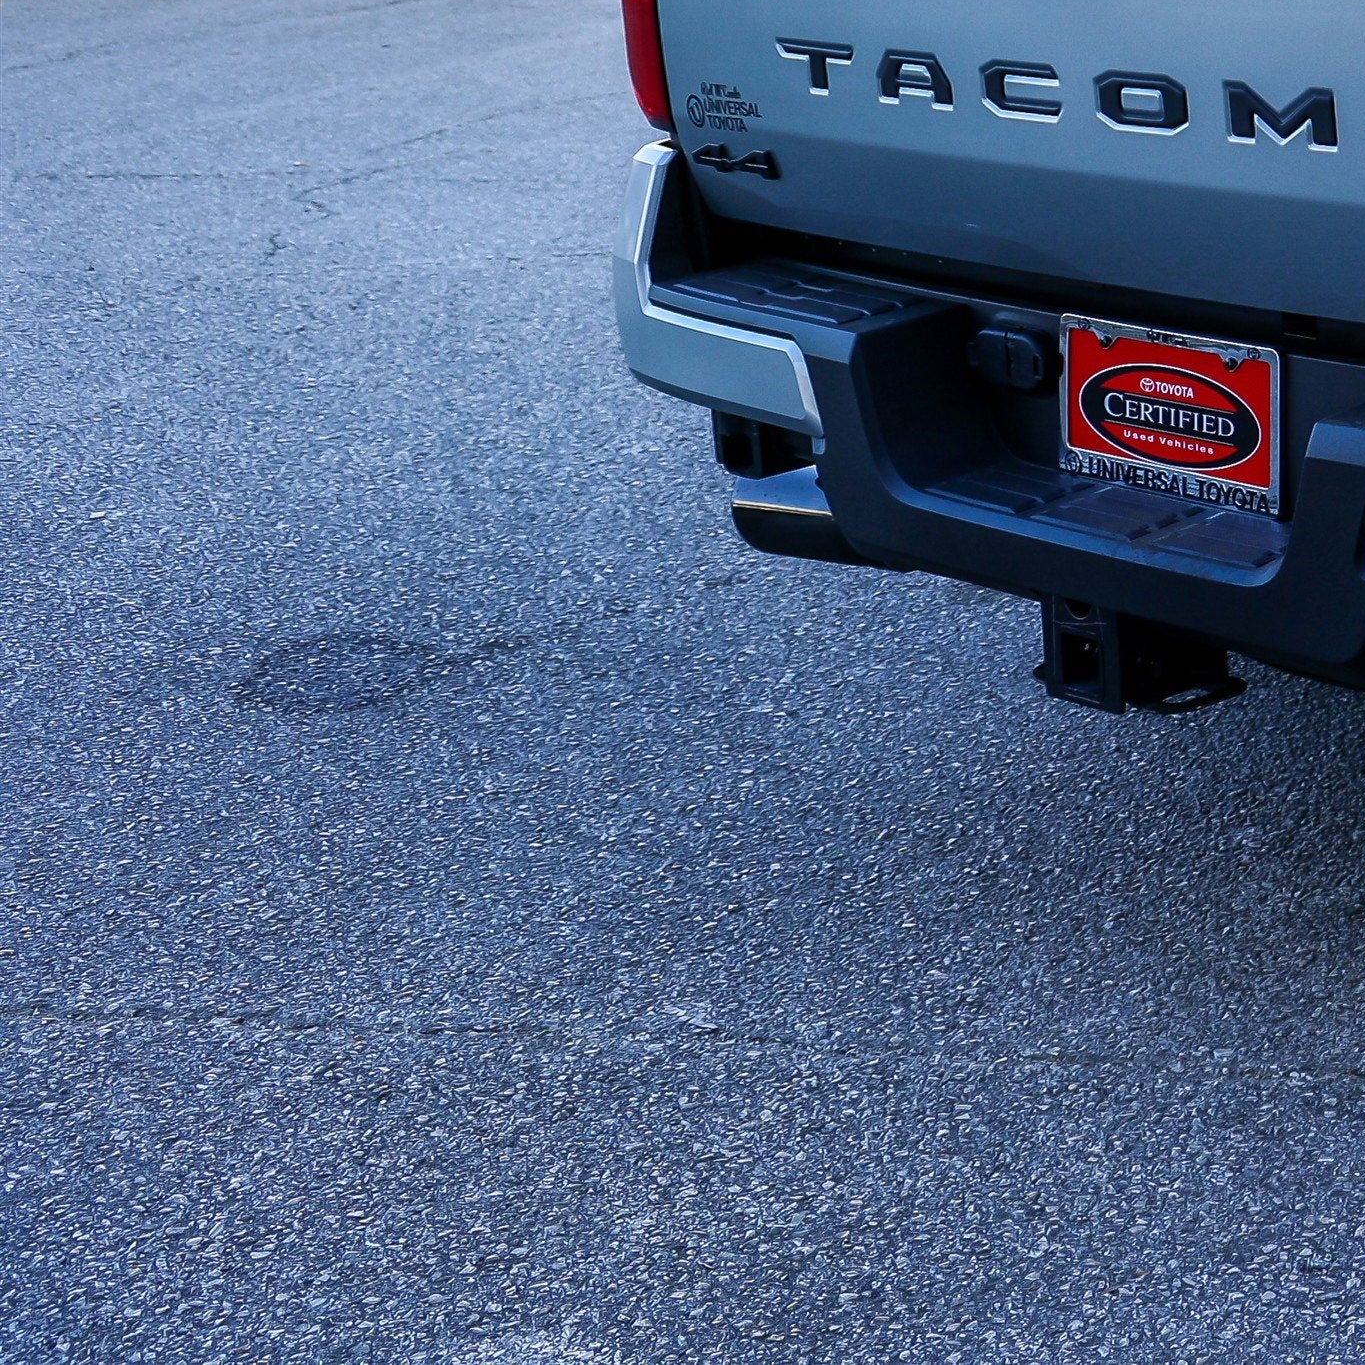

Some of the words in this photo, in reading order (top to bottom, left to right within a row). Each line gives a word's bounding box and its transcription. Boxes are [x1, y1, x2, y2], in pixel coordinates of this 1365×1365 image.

[703, 97, 763, 119] UNIVERSAL
[706, 114, 748, 133] TOYOTA
[1155, 380, 1195, 399] TOYOTA
[1122, 429, 1154, 443] Used
[1159, 436, 1215, 455] Vehicles
[1087, 454, 1193, 497] UNIVERSAL
[1195, 477, 1270, 514] TOYOTA
